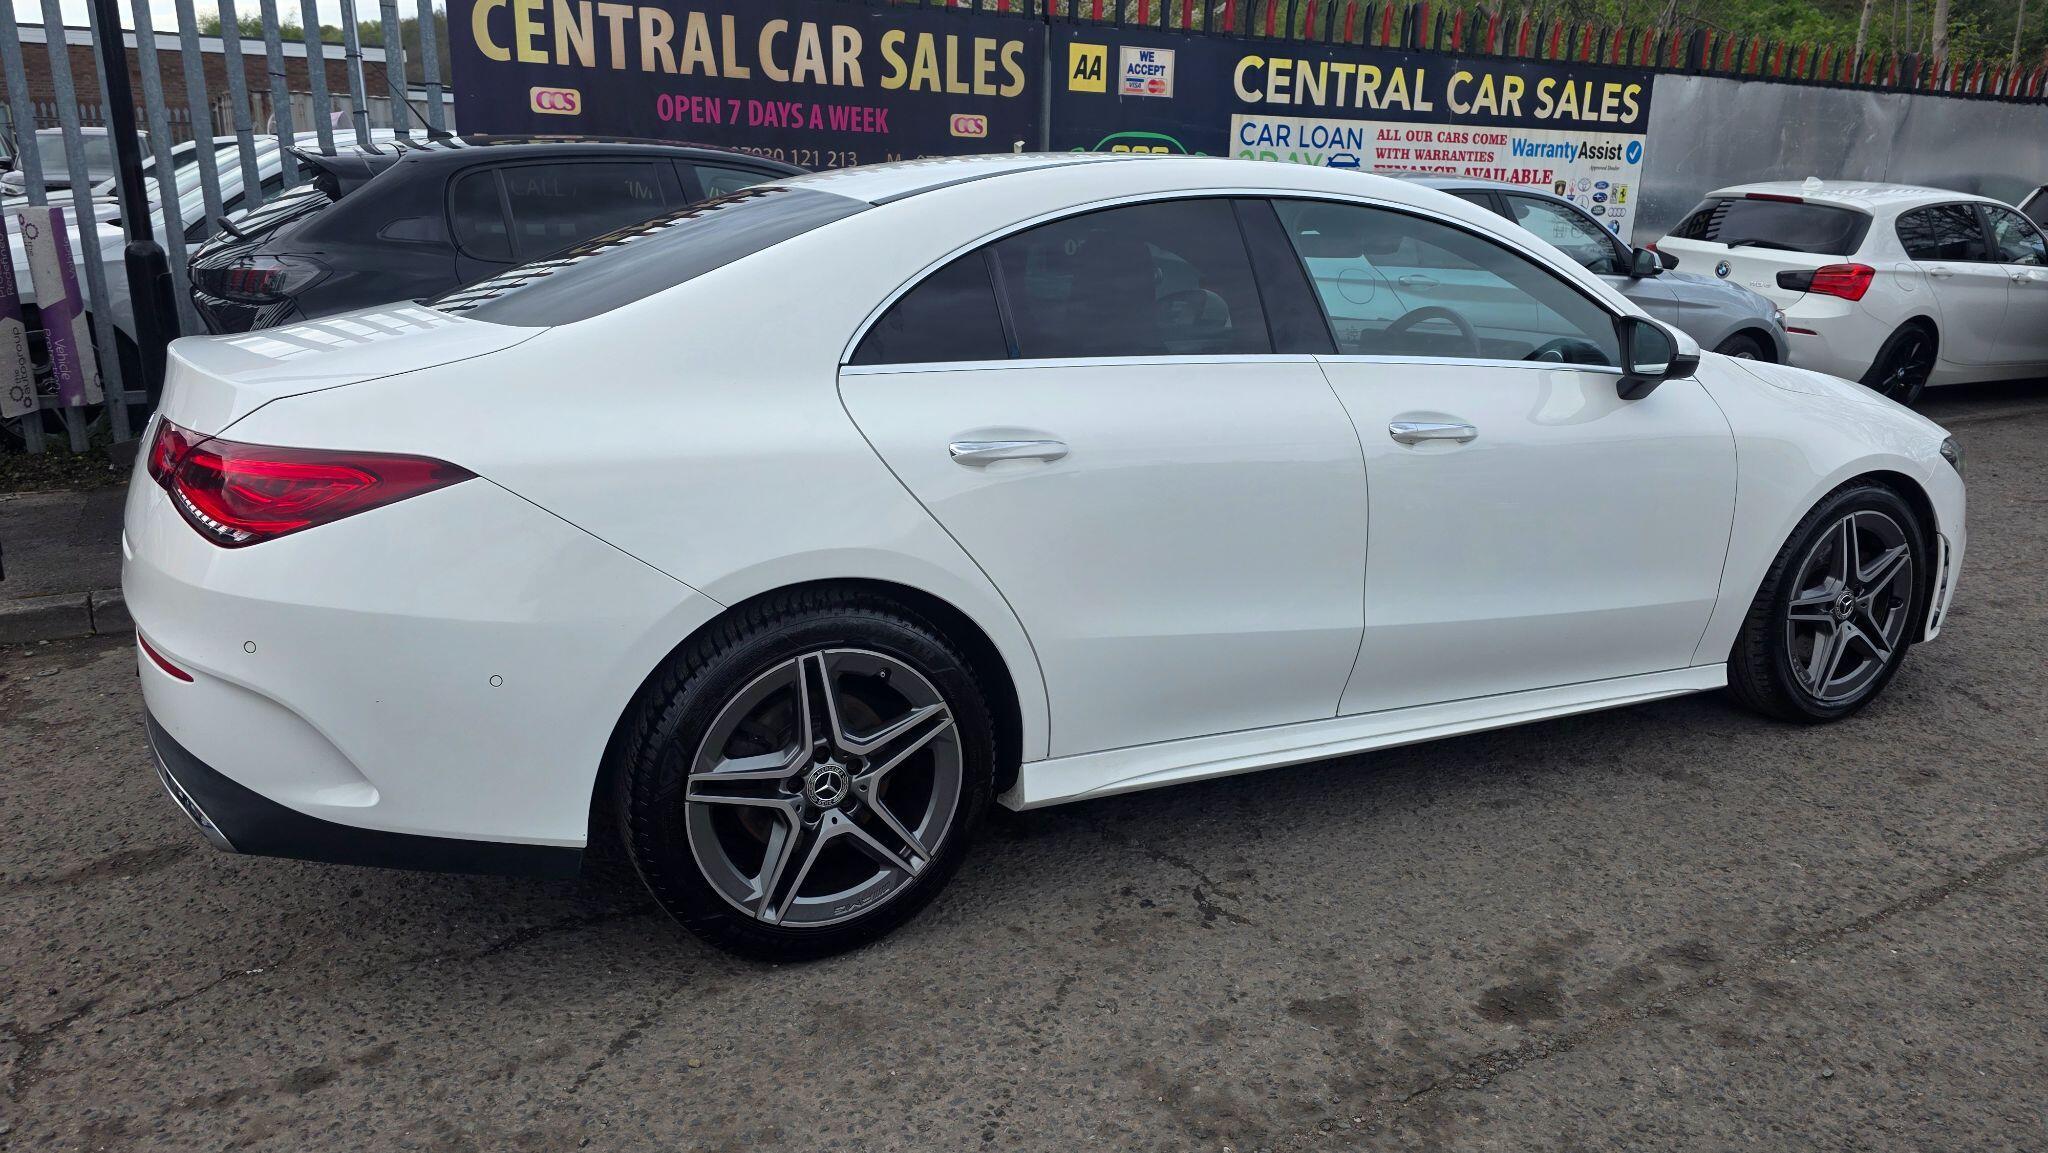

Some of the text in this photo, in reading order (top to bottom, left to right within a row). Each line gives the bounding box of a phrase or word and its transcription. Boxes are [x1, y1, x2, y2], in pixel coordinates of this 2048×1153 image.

[471, 0, 1025, 97] CENTRAL CAR SALES
[1140, 51, 1155, 62] WE
[1073, 54, 1102, 80] AA
[1127, 63, 1166, 76] ACCEPT
[1234, 55, 1642, 124] CENTRAL CAR SALES
[657, 93, 889, 133] OPEN 7 DAYS A WEEK
[1239, 122, 1364, 149] CAR LOAN
[1377, 129, 1508, 146] ALL OUR CARS COME
[791, 149, 819, 166] 121
[827, 151, 858, 167] 213
[1376, 147, 1495, 163] WITH WARRANTIES
[55, 338, 71, 380] Vehicle
